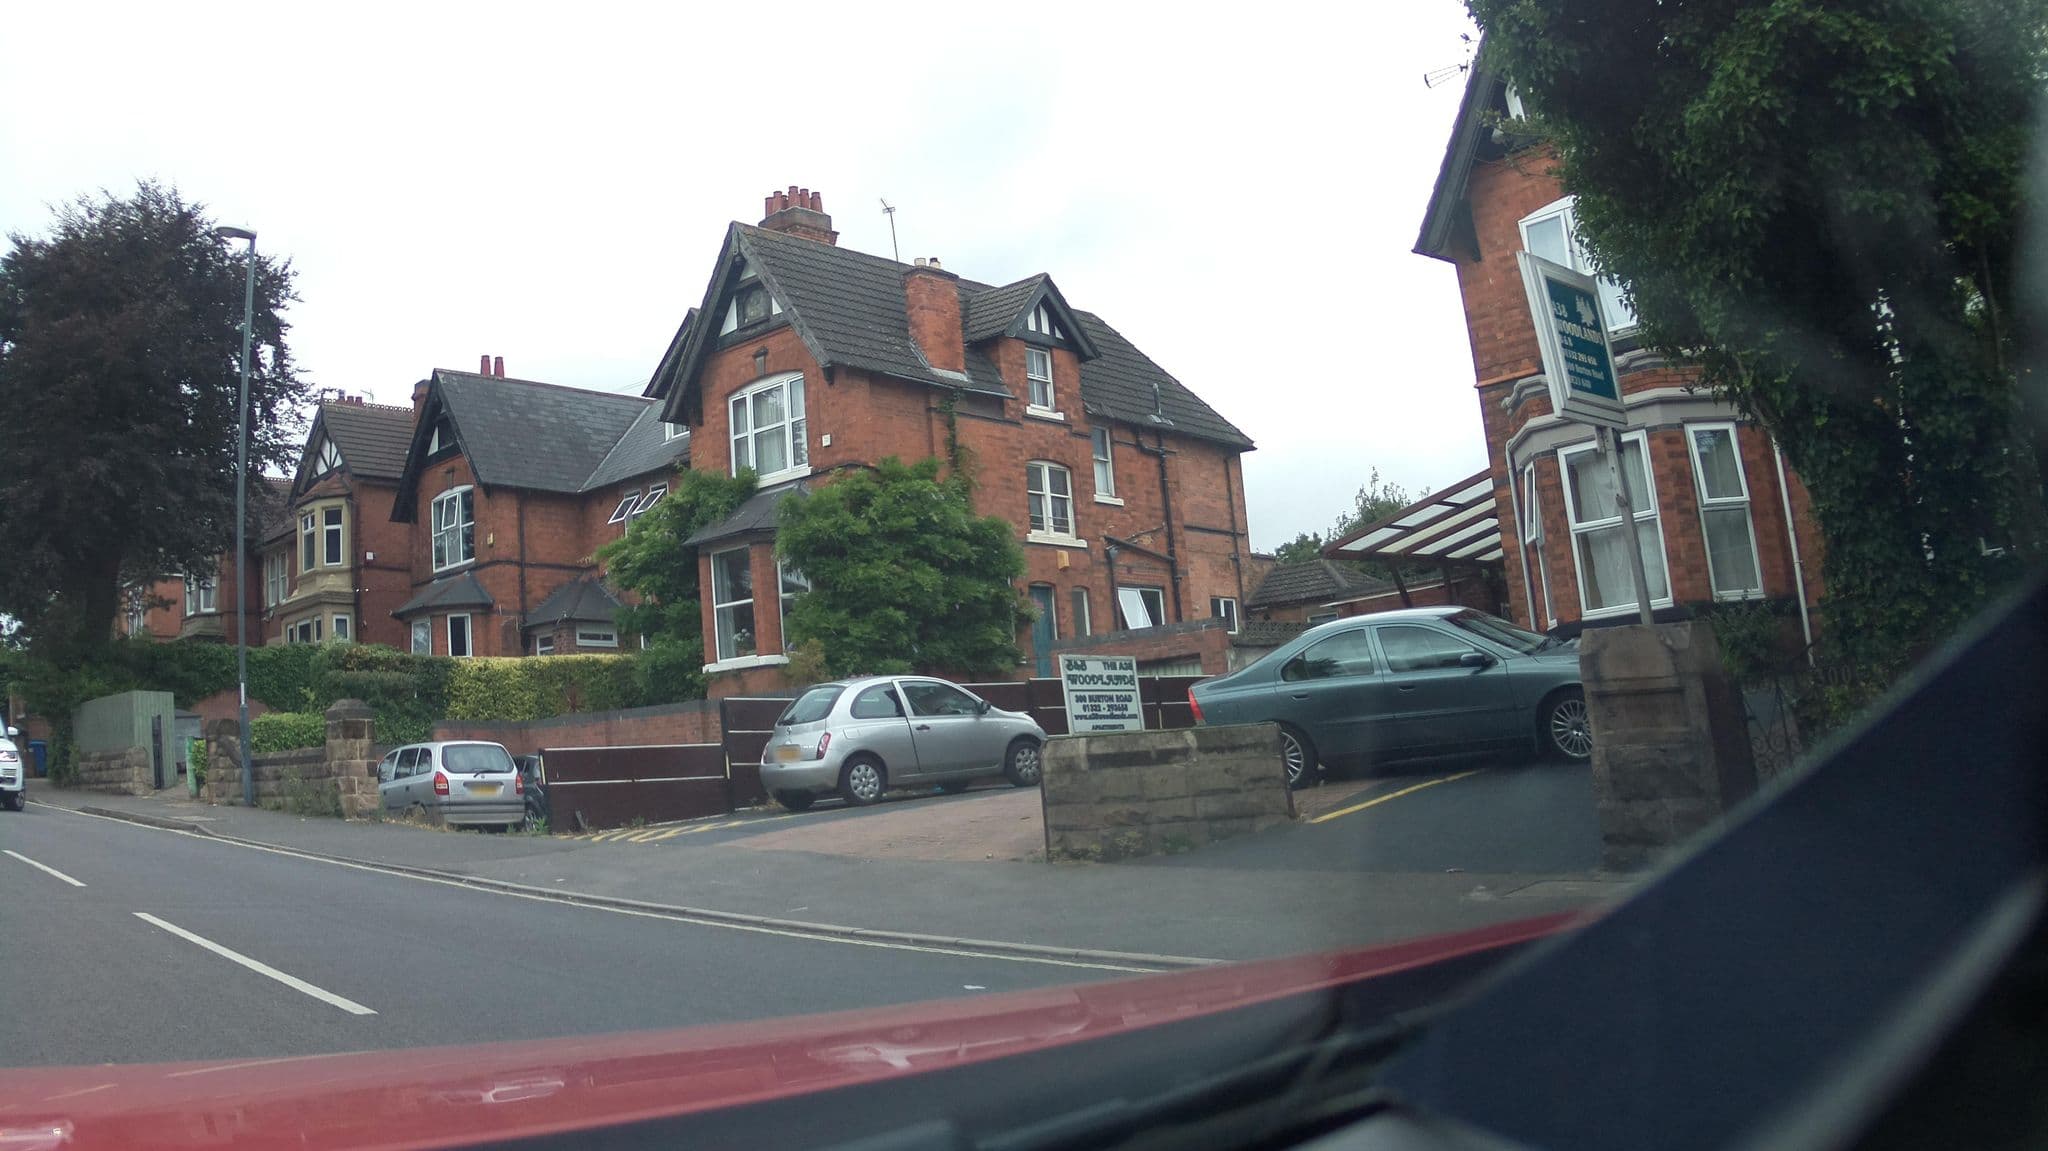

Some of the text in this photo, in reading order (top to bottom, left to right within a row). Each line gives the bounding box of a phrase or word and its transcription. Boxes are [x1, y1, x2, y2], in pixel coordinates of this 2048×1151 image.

[1066, 674, 1136, 686] WOODLANDS
[1088, 694, 1115, 703] BURTON
[1116, 694, 1133, 703] ROAD
